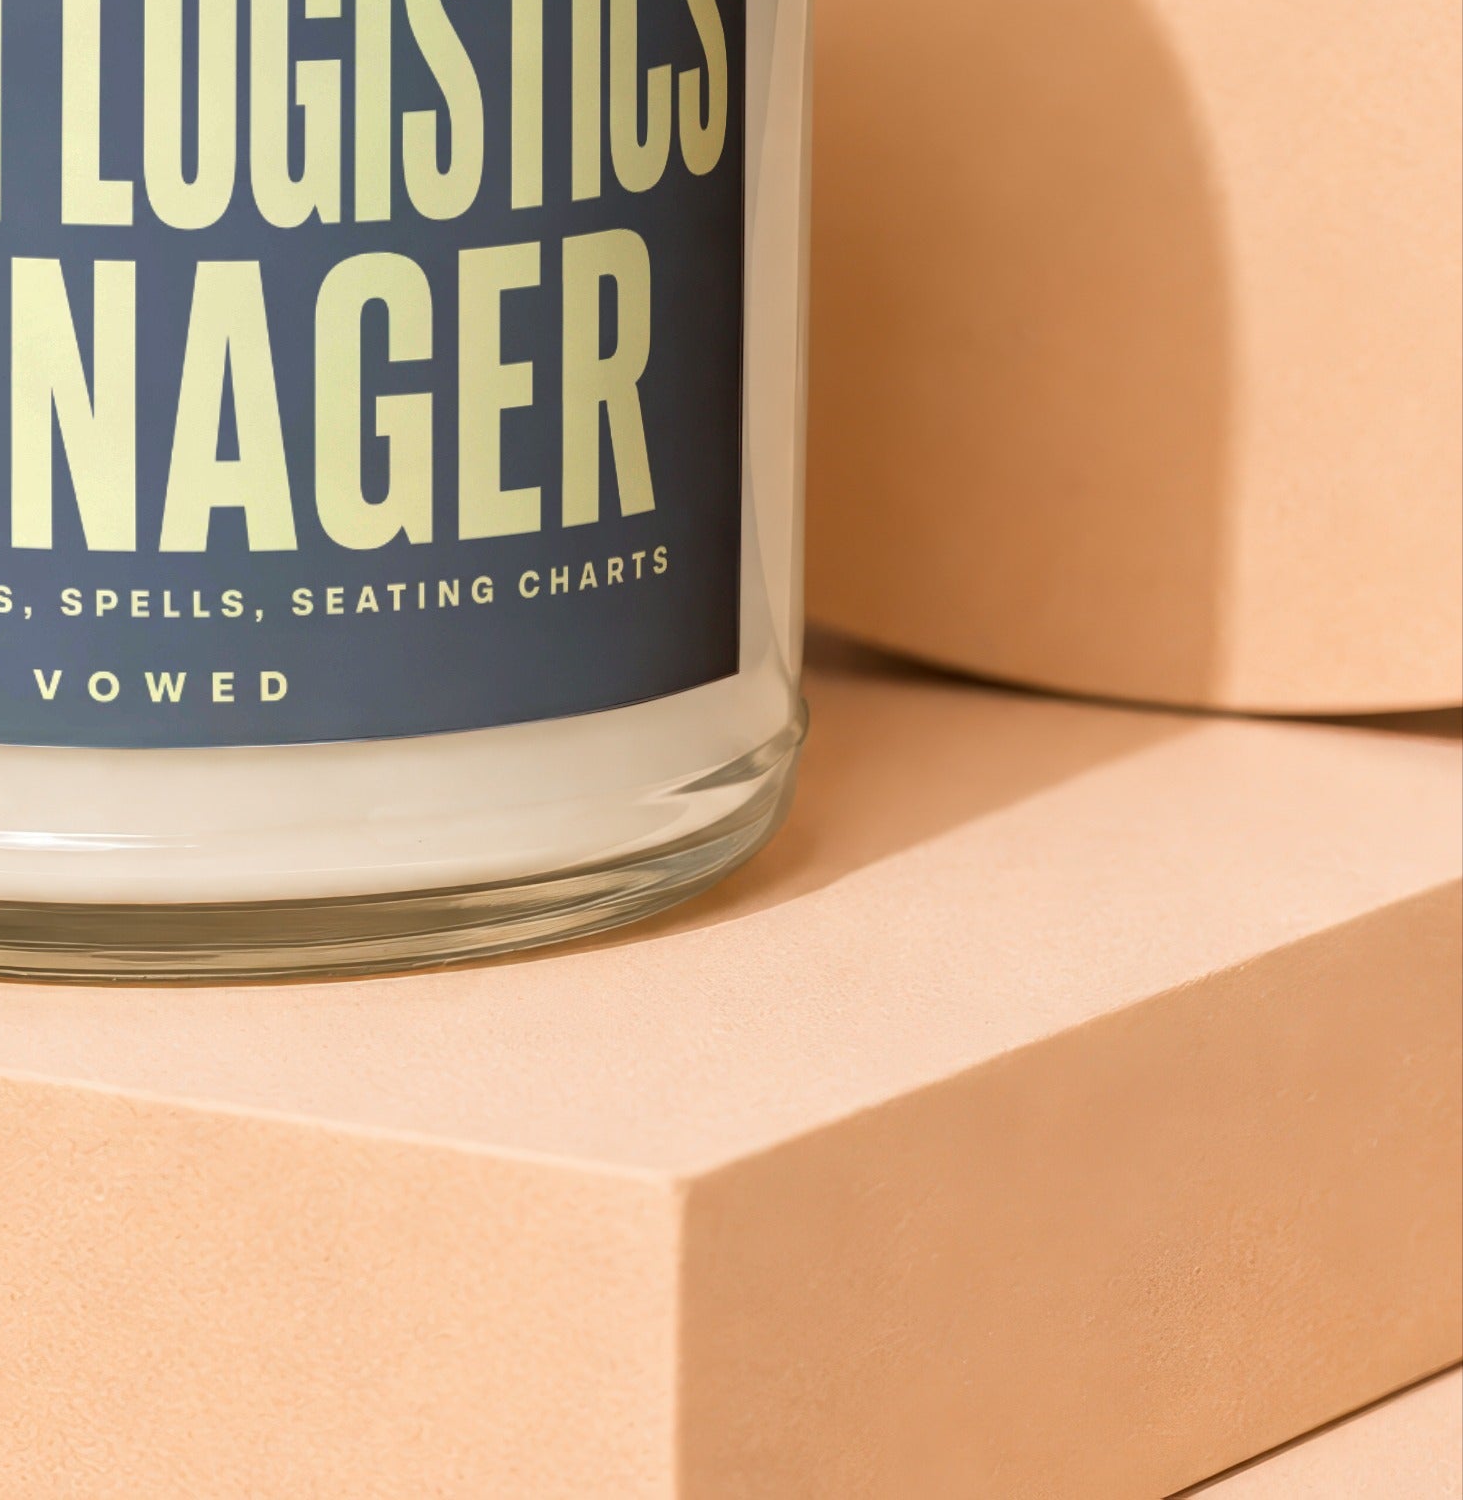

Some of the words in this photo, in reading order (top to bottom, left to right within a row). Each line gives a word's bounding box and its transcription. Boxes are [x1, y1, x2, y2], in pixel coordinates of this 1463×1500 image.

[59, 587, 266, 622] SPELLS,
[290, 575, 496, 617] SEATING
[516, 546, 671, 600] CHARTS
[32, 668, 290, 704] VOWED
